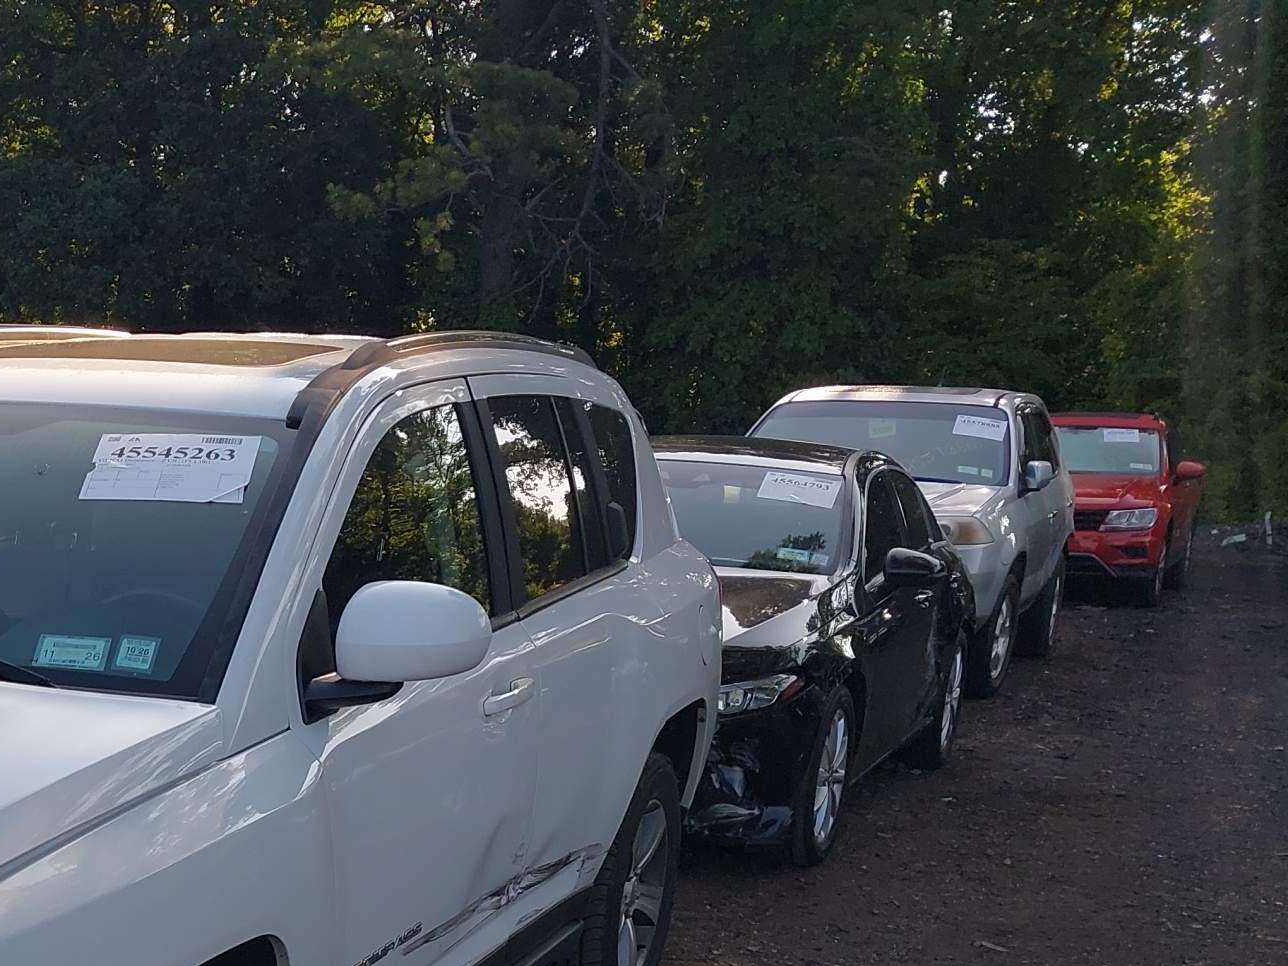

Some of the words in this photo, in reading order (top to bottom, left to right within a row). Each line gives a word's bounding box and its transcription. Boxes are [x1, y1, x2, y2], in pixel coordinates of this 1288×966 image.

[111, 446, 236, 462] 45545263
[43, 649, 55, 658] 11
[84, 651, 101, 662] 26
